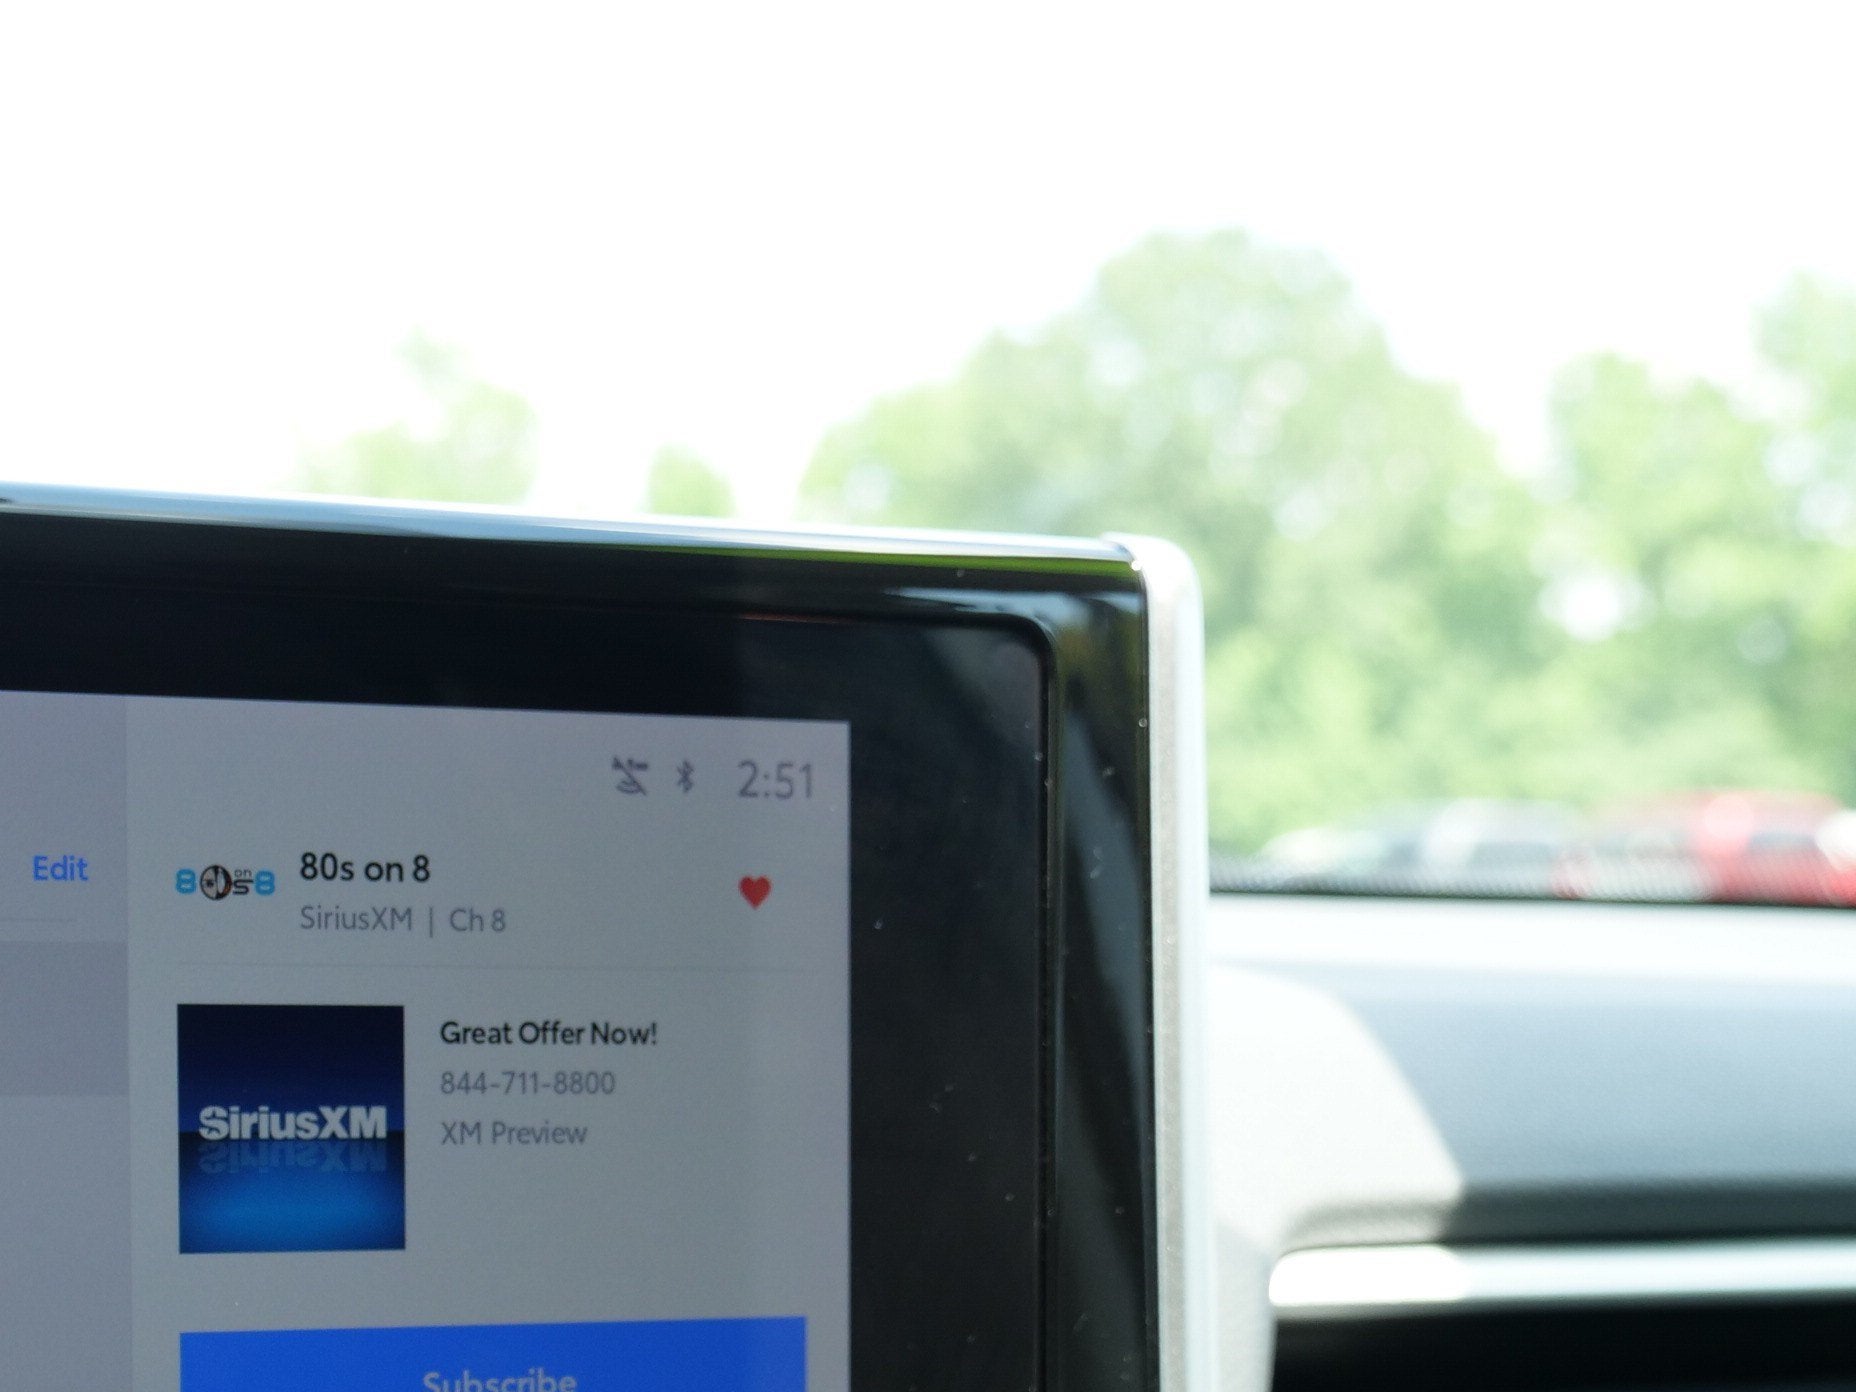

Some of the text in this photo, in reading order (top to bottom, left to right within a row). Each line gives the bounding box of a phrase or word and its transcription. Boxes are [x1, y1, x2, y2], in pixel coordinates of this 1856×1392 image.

[738, 760, 816, 800] 2:51
[32, 854, 89, 882] Edit
[299, 852, 432, 884] 80s on 8
[299, 905, 507, 934] SiriusXM Ch 8
[440, 1020, 658, 1047] Great Offer Now!
[440, 1070, 616, 1096] 844-711-8800
[199, 1105, 388, 1141] SiriusXM
[441, 1120, 587, 1147] XM Preview
